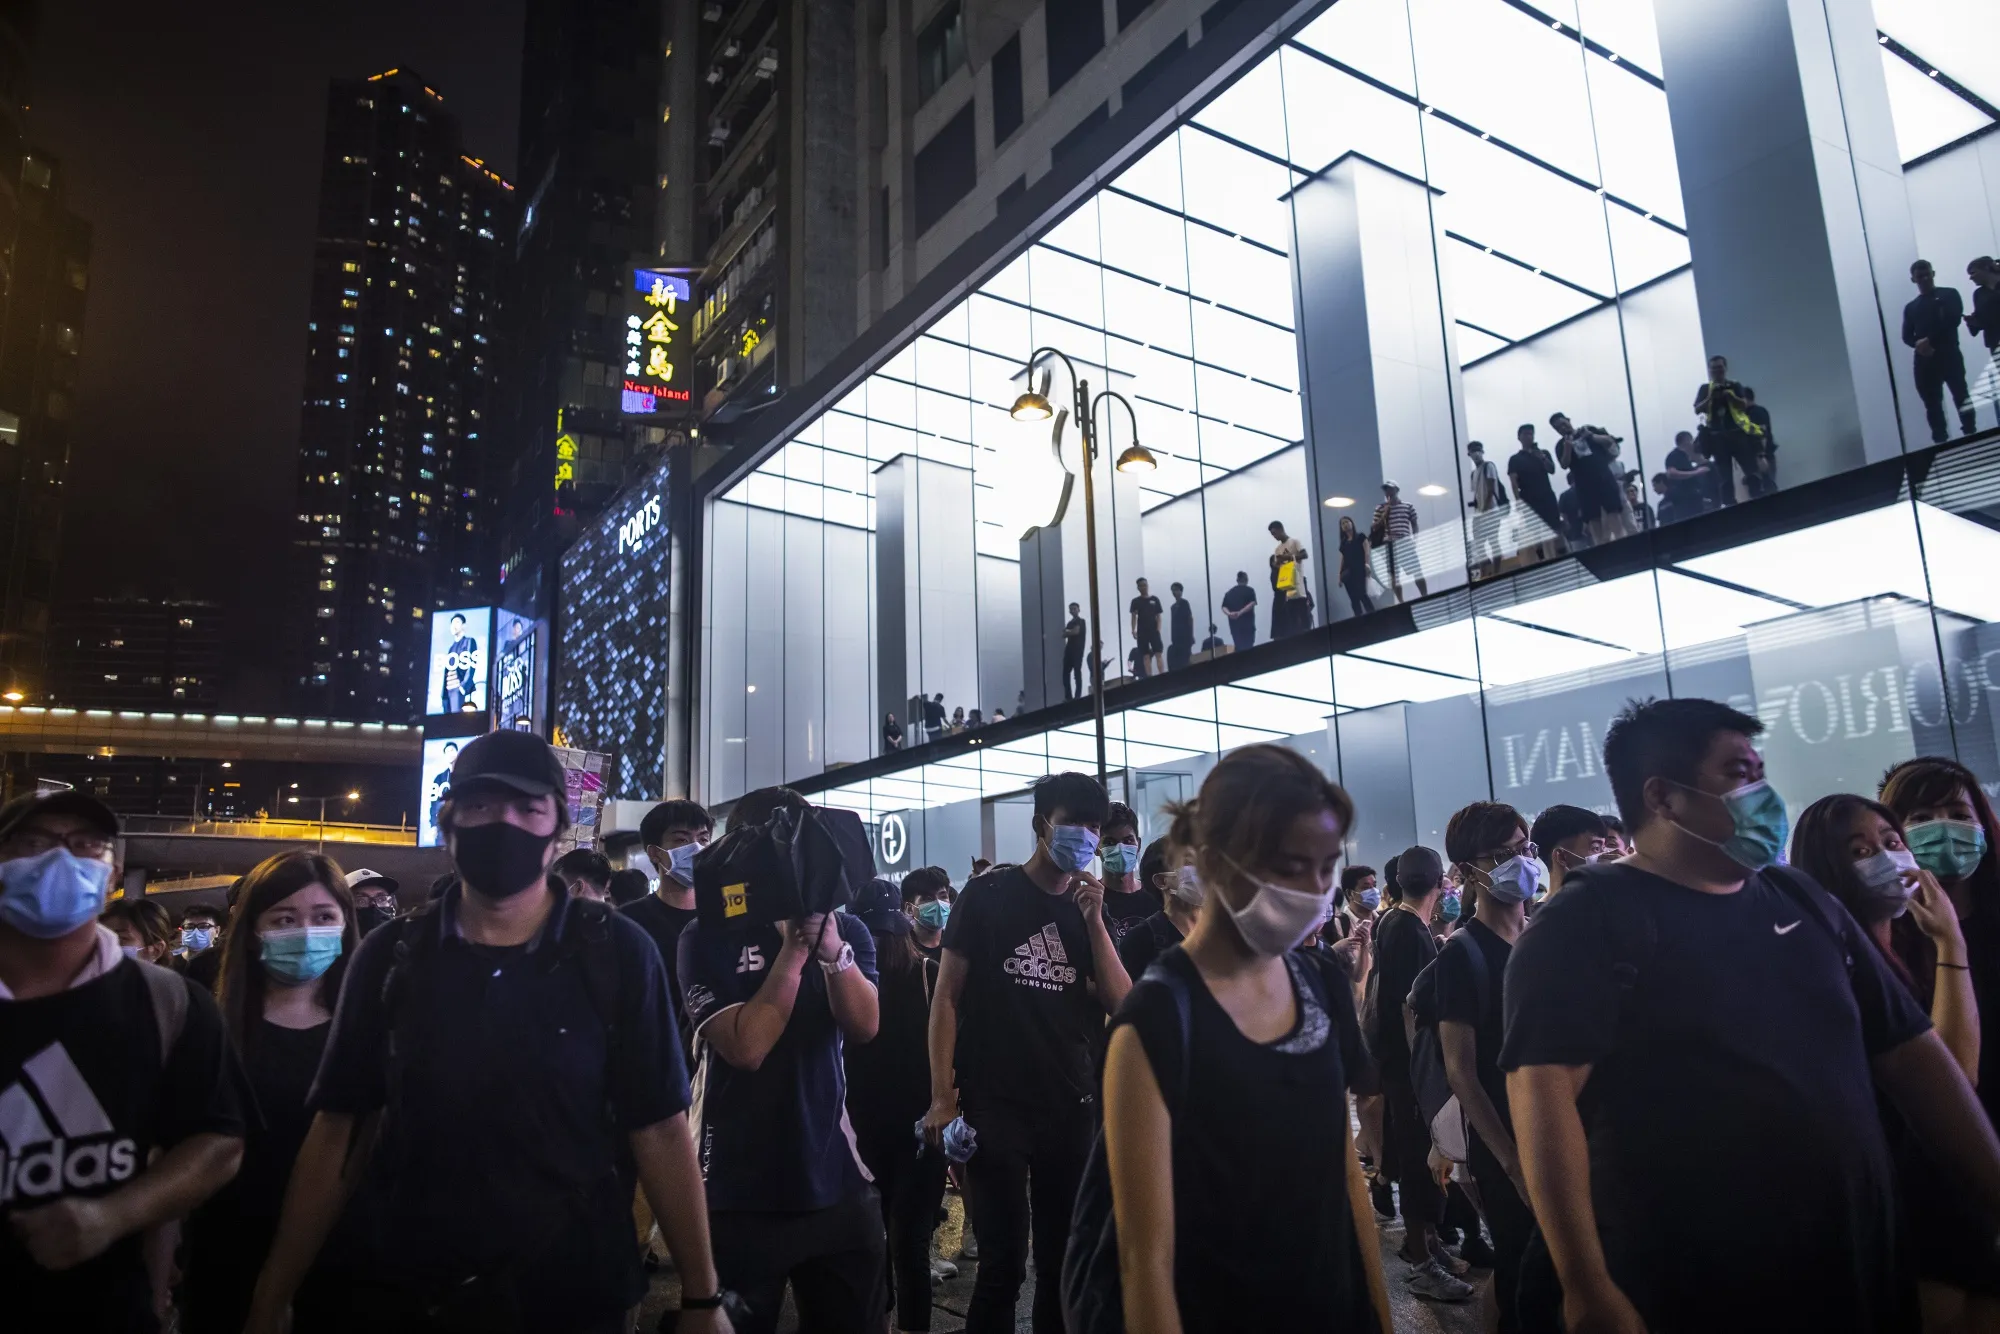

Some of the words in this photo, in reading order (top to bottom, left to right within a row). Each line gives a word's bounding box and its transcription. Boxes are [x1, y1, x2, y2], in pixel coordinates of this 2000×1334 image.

[624, 380, 650, 394] New
[652, 385, 690, 400] Island
[618, 494, 661, 555] PORTS
[434, 649, 484, 673] BOSS
[1003, 954, 1077, 984] adidas
[1014, 977, 1041, 988] HONG
[1042, 981, 1065, 993] KONG
[0, 1136, 136, 1202] idas
